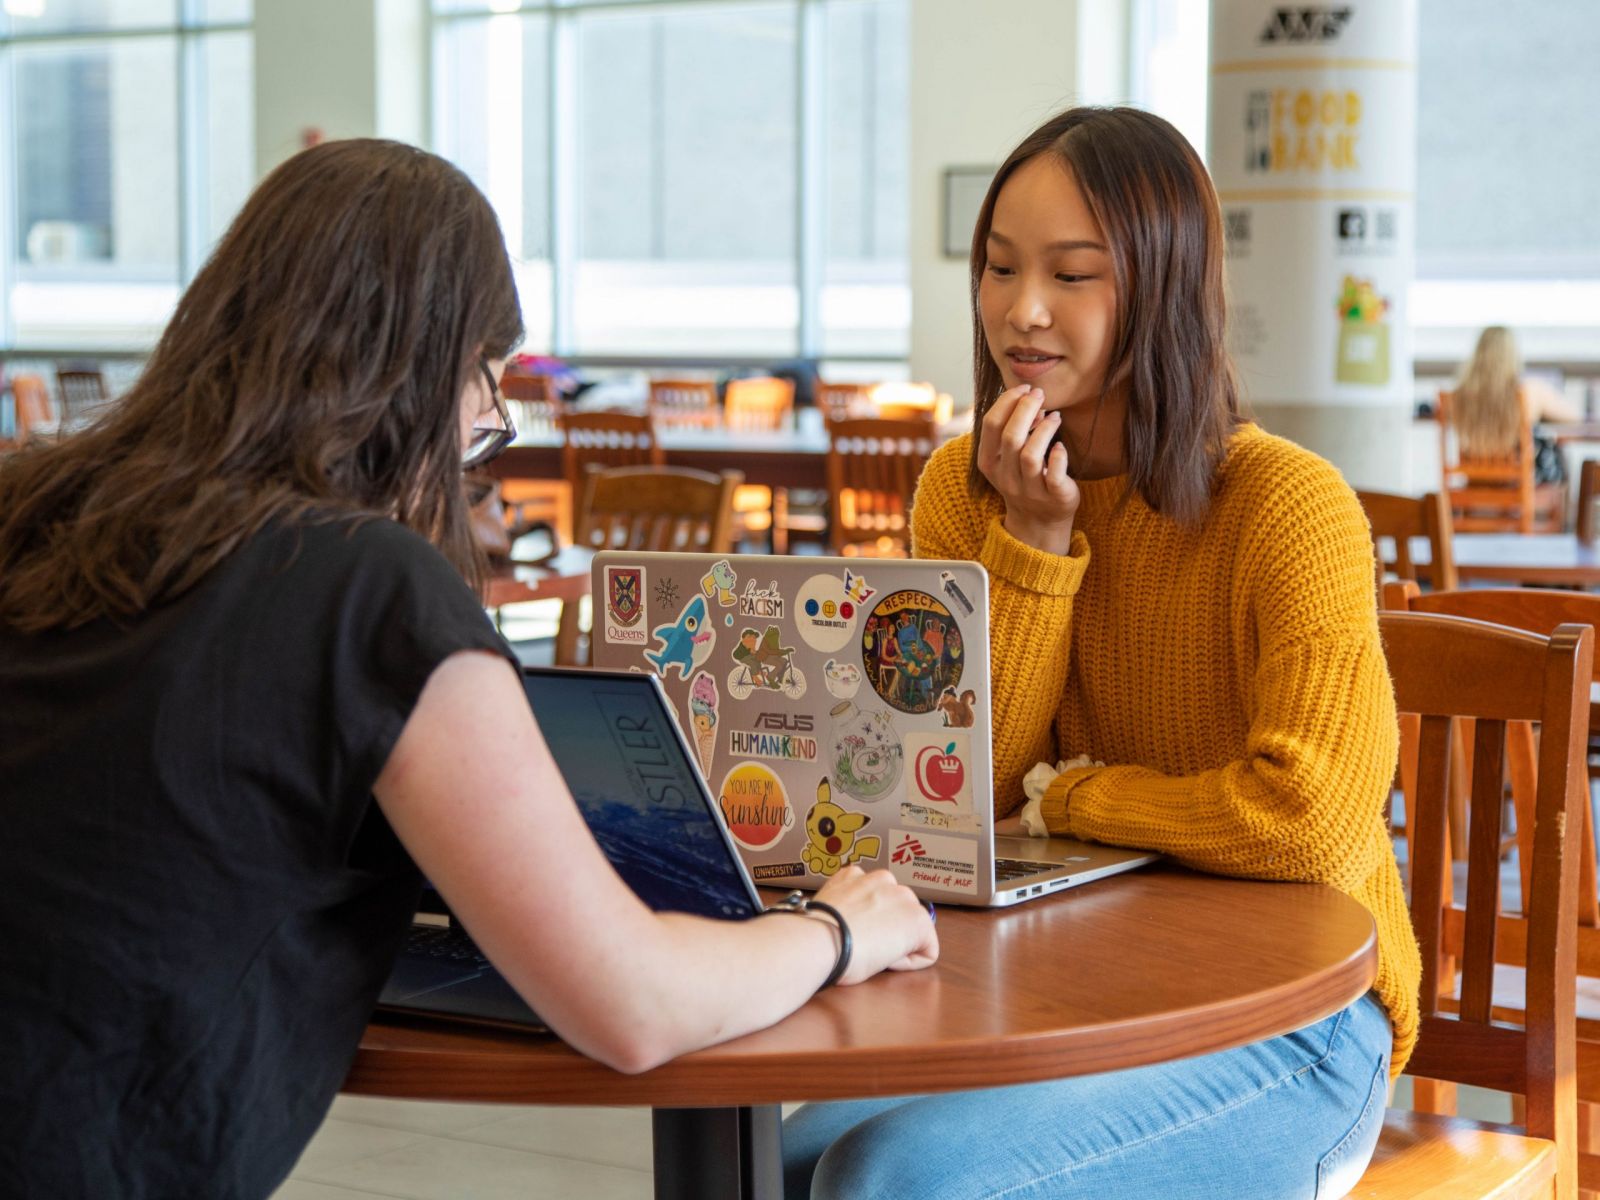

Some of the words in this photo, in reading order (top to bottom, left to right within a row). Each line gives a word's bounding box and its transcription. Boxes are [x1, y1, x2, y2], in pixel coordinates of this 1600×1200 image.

[1271, 89, 1361, 128] FOOD
[1271, 132, 1360, 173] BANK
[740, 597, 783, 617] RACISM
[884, 592, 936, 611] RESPECT
[833, 621, 848, 629] OUTLET
[754, 712, 814, 732] ASUS
[732, 732, 816, 759] HUMANKIND
[730, 779, 747, 794] YOU
[749, 779, 762, 796] ARE
[764, 780, 774, 796] MY
[720, 792, 792, 829] Sunshine
[912, 871, 940, 883] Friends
[943, 876, 952, 886] of
[954, 878, 973, 887] MSF
[933, 865, 954, 873] WITHOUT
